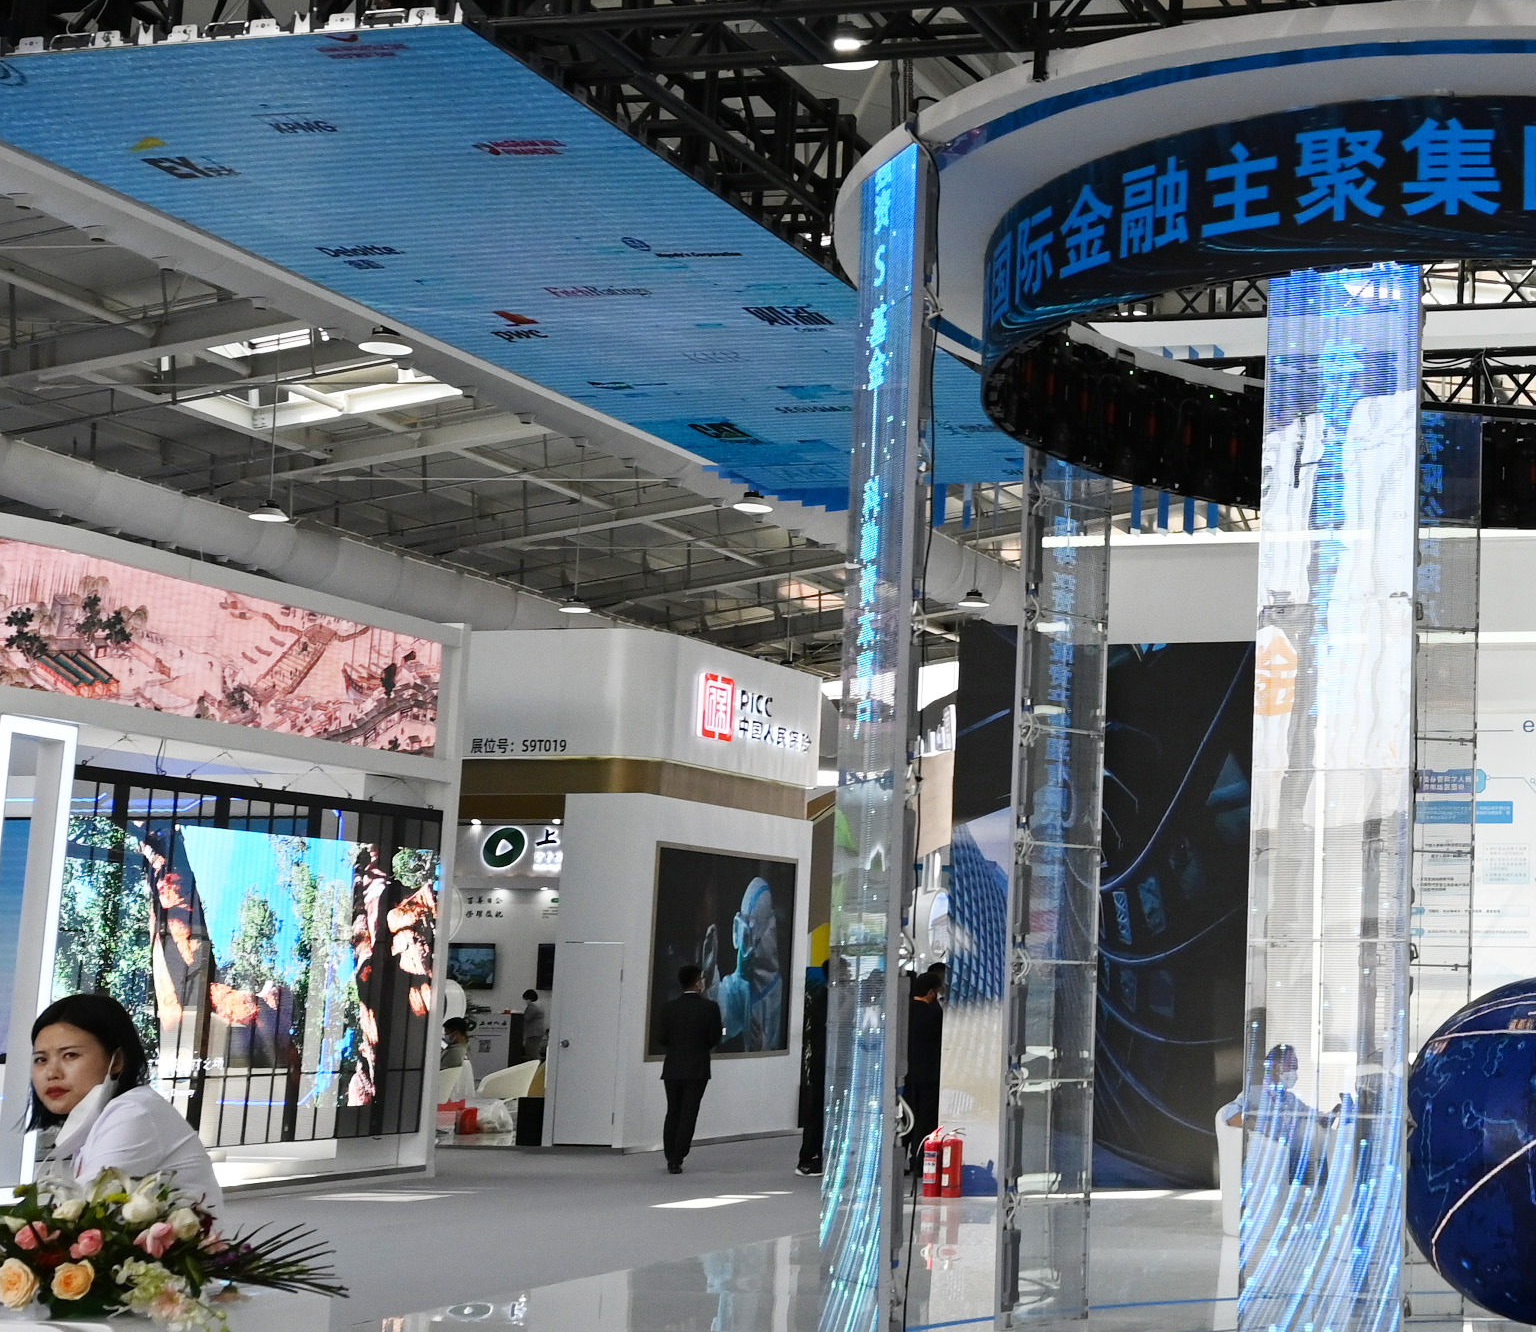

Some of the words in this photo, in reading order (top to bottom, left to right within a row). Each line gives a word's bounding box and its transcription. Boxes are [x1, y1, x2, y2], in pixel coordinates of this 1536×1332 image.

[269, 121, 338, 134] KPMG
[140, 156, 214, 179] EY
[490, 329, 549, 343] pwc
[740, 689, 773, 717] PICC
[739, 716, 812, 752] 中国人民保险
